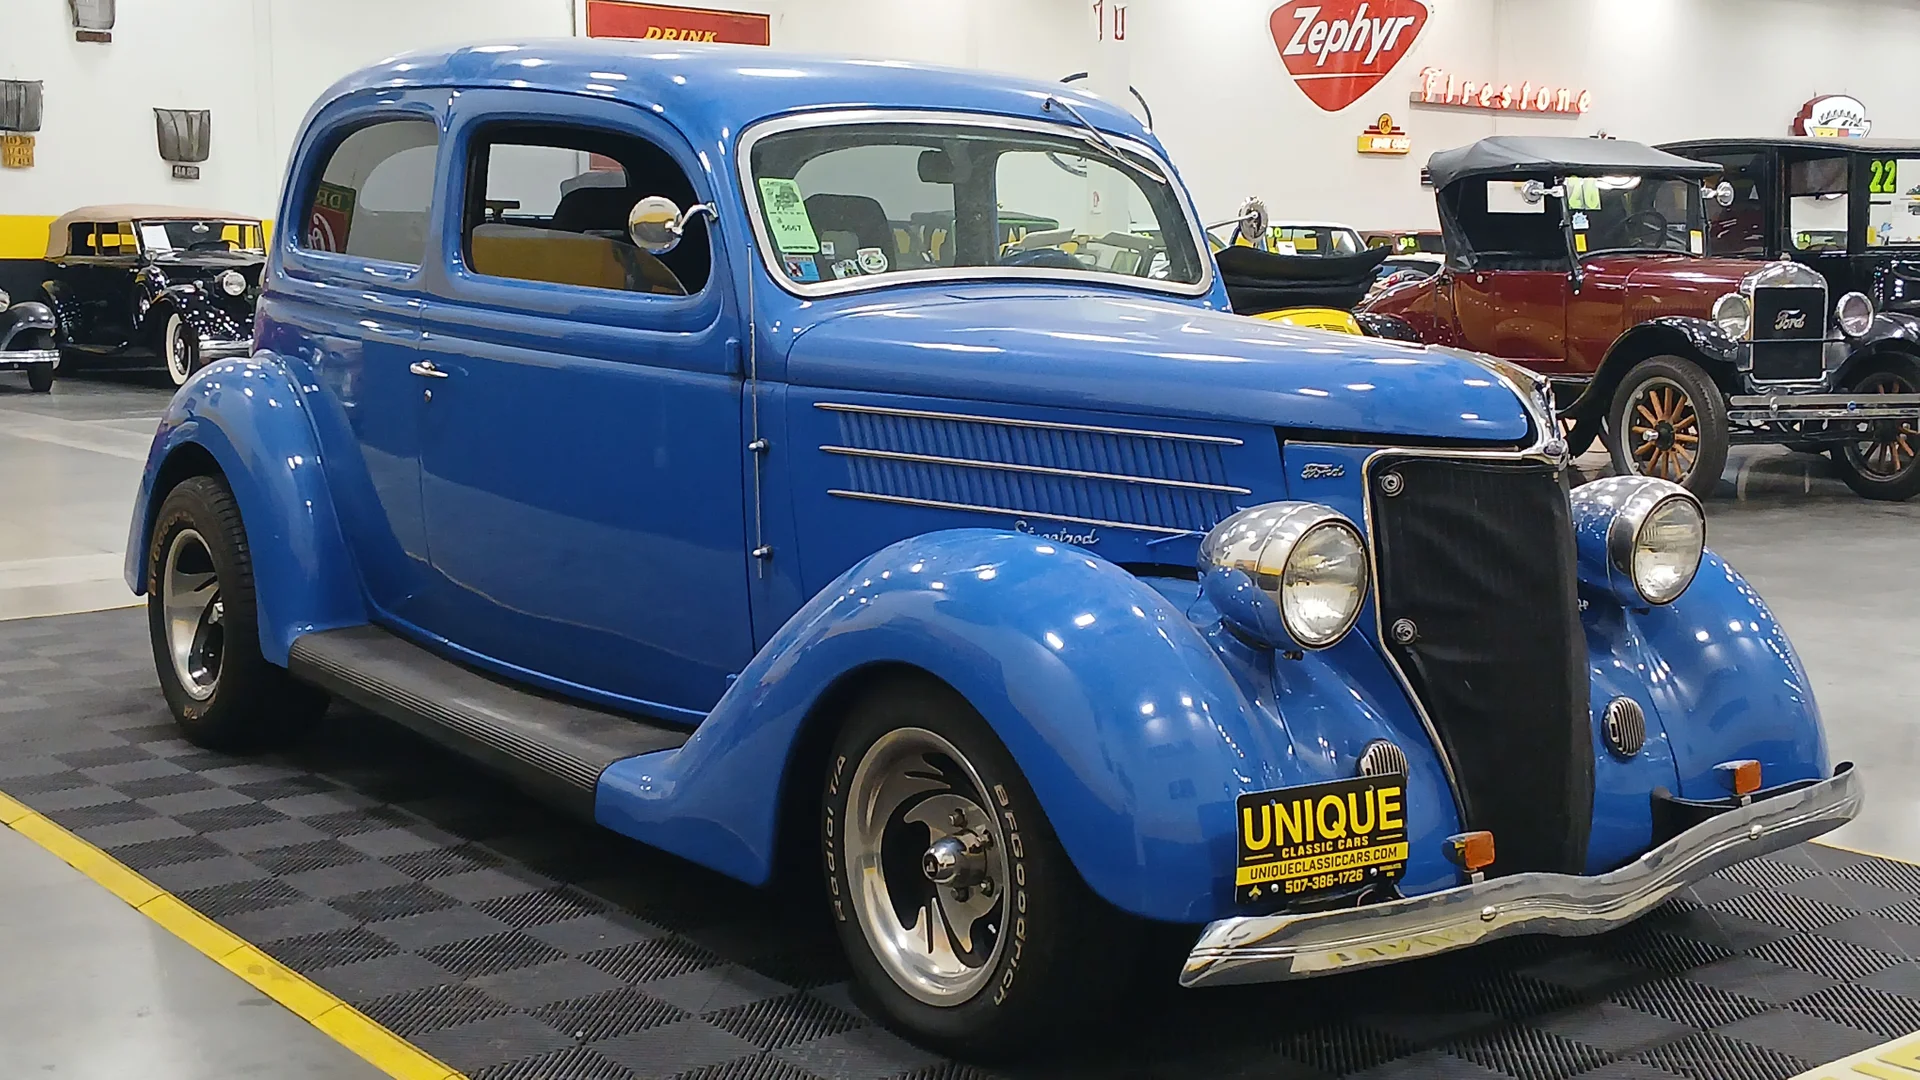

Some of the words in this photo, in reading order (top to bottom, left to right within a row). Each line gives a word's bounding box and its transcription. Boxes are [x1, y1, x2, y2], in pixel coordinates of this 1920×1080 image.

[644, 26, 718, 43] DRINK
[1282, 3, 1415, 66] Zephyr
[1419, 66, 1592, 113] Firestone
[1869, 160, 1896, 193] 22
[1774, 309, 1806, 330] Ford
[1301, 463, 1345, 479] Ford
[1243, 787, 1403, 850] UNIQUE
[1281, 841, 1334, 859] CLASSIC
[1338, 836, 1369, 850] CARS
[1250, 846, 1397, 880] UNIQUECLASSICCARS.COM
[1285, 868, 1363, 894] 507-386-1726
